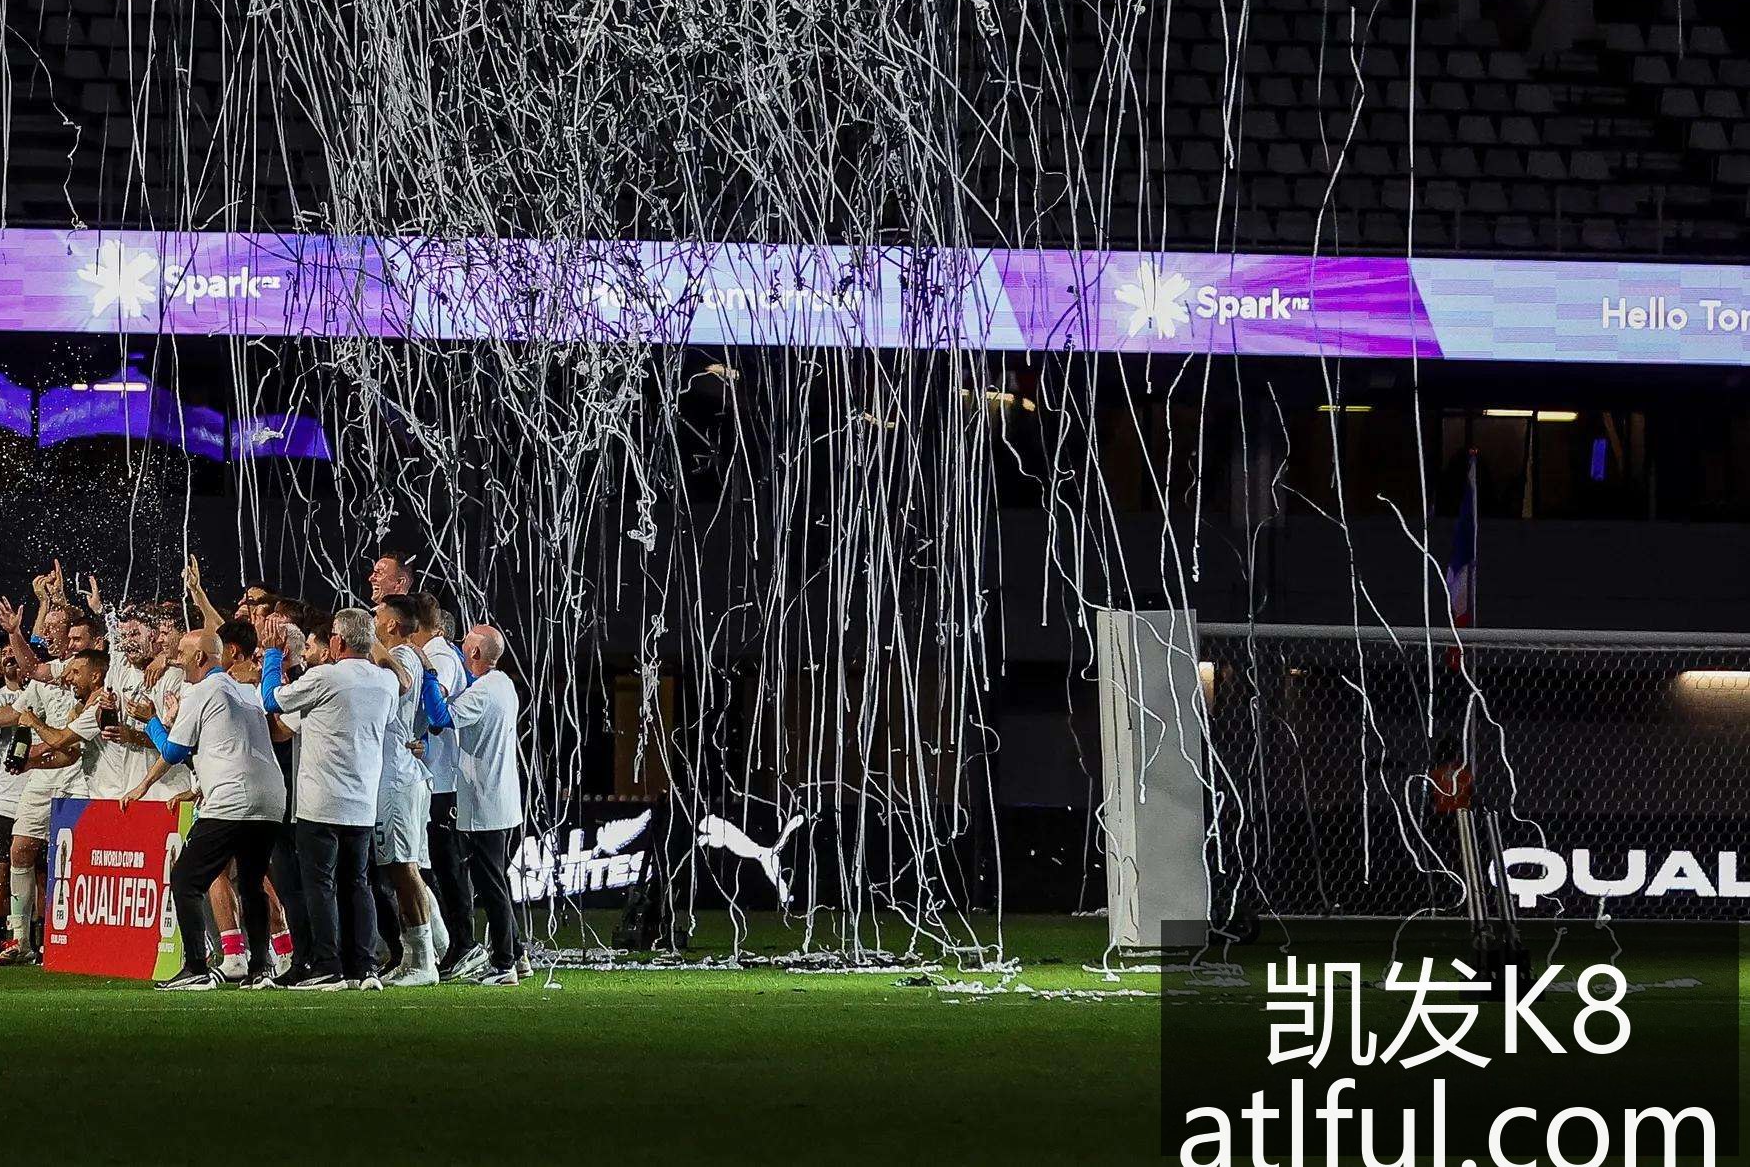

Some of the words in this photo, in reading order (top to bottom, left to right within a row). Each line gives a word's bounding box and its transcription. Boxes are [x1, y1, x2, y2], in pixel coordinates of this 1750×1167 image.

[164, 264, 261, 304] Spark
[1196, 285, 1291, 325] Spark
[1602, 296, 1688, 330] Hello
[73, 874, 158, 928] QUALIFIED
